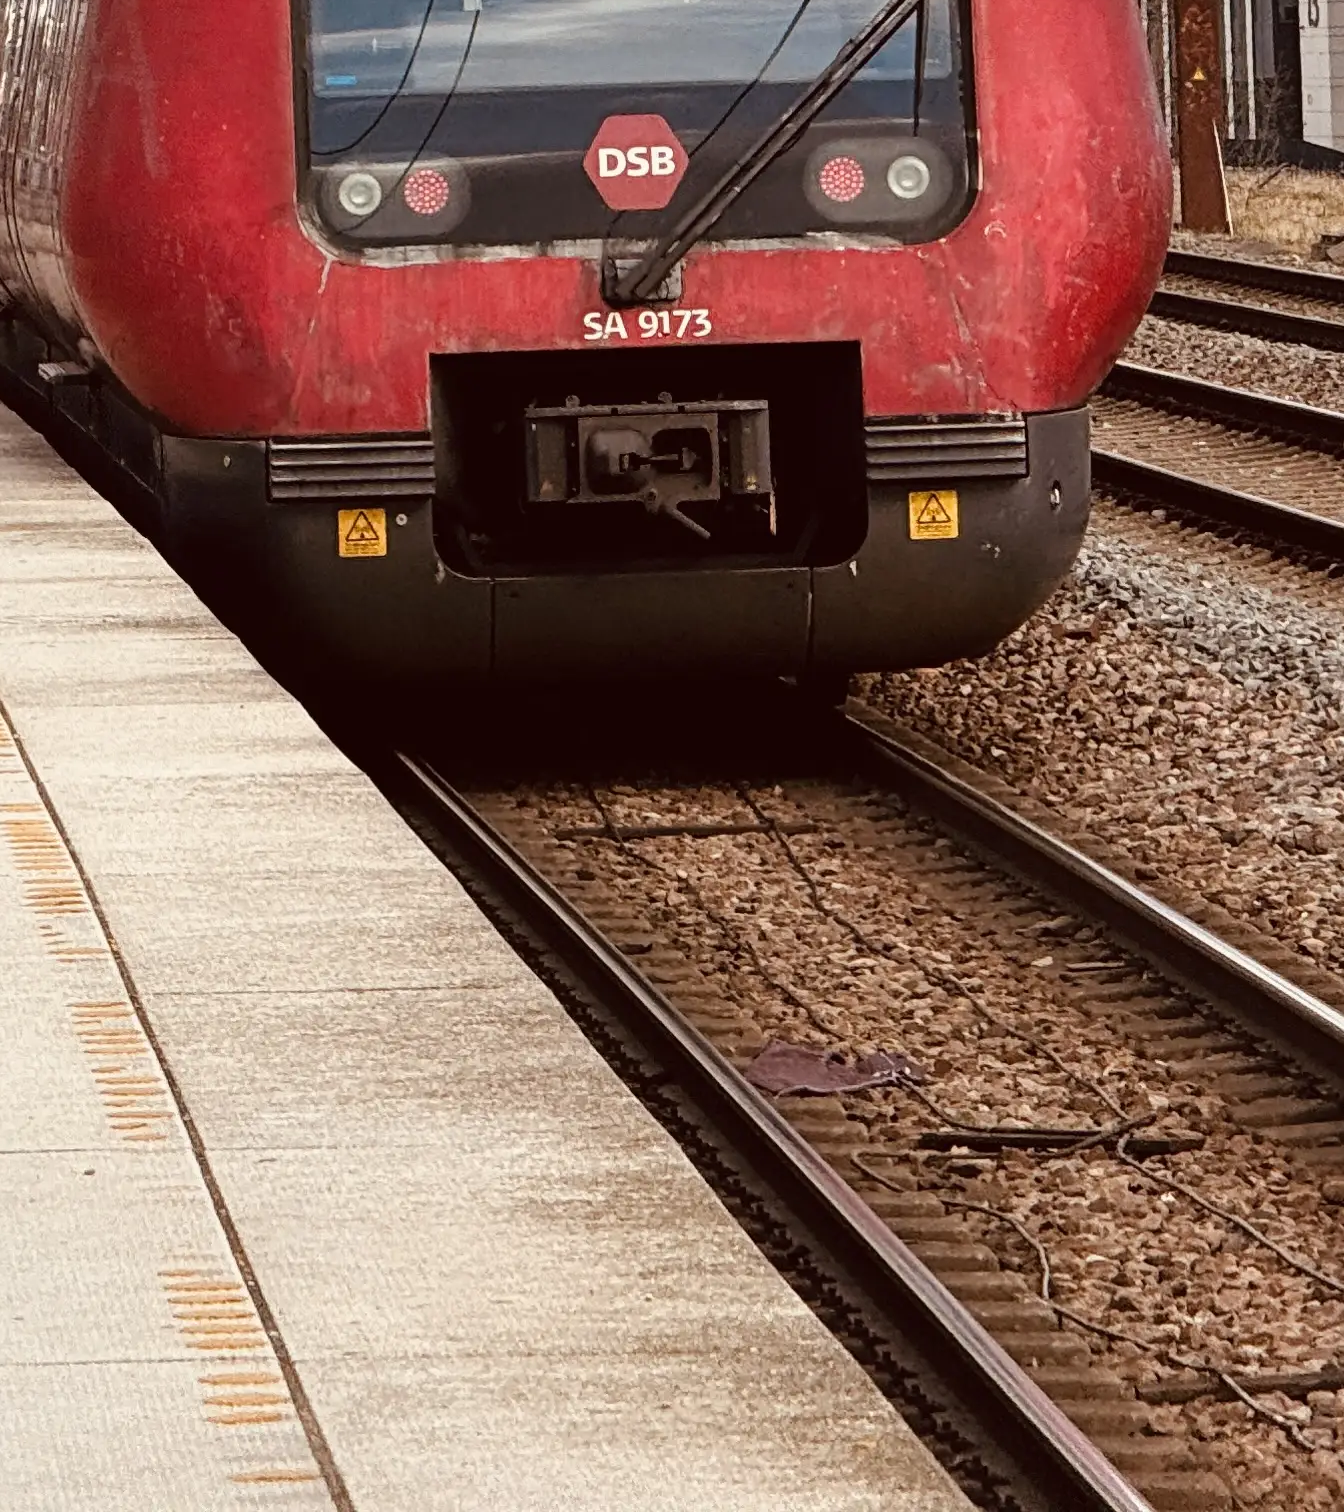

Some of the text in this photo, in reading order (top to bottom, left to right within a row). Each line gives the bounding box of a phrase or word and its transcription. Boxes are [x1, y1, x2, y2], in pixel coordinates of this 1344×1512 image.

[598, 146, 676, 178] DSB
[583, 309, 712, 340] SA 9173
